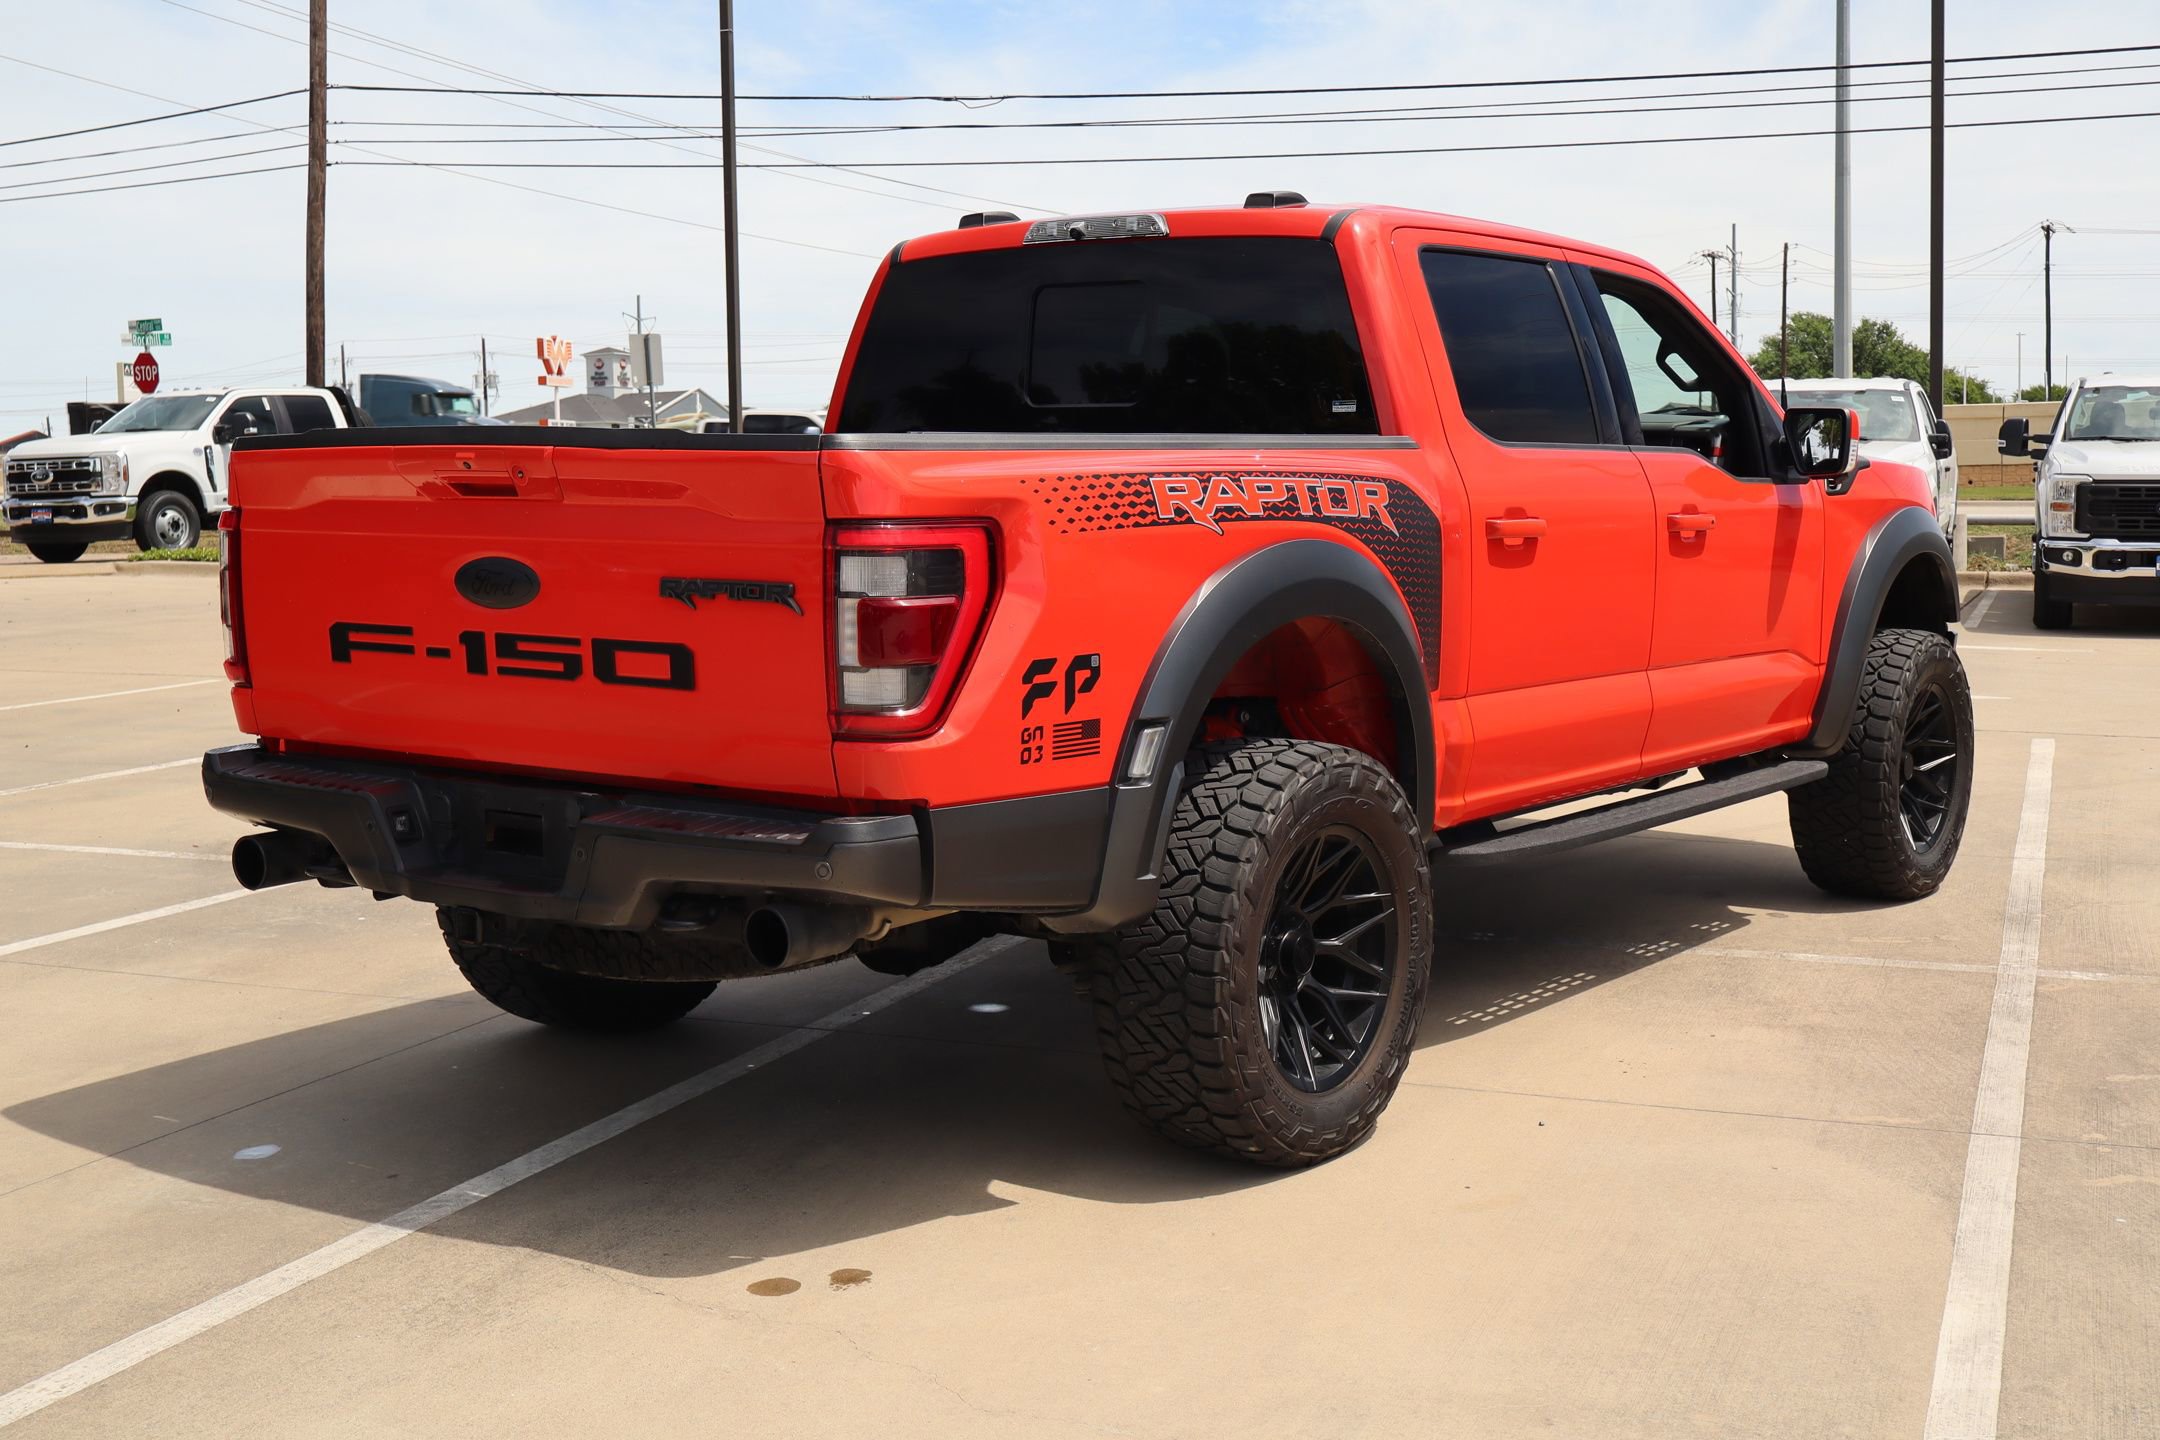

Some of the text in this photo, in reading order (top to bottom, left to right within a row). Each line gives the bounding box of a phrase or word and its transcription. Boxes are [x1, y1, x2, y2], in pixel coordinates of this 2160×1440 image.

[135, 365, 157, 381] STOP
[1149, 477, 1400, 537] RAPTOR
[471, 569, 515, 596] Ford
[660, 577, 804, 616] RAPTOR
[329, 621, 696, 691] F-150
